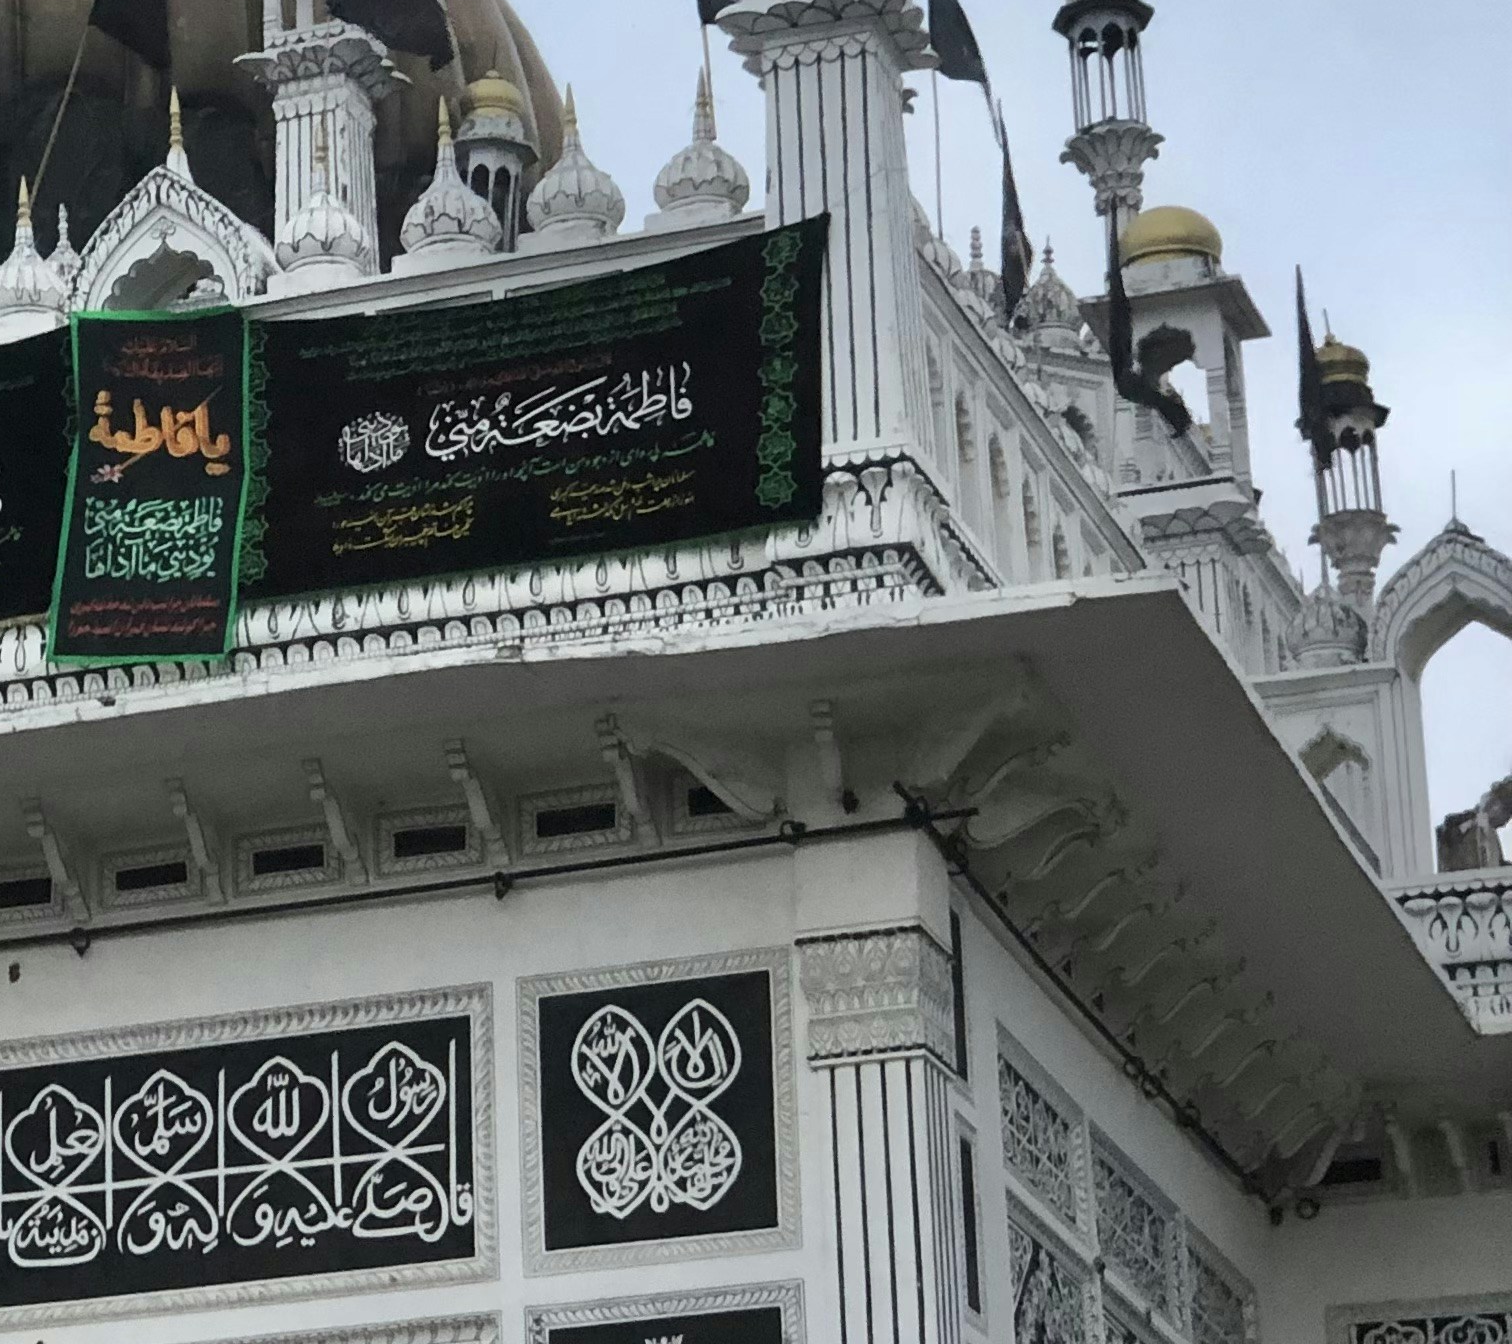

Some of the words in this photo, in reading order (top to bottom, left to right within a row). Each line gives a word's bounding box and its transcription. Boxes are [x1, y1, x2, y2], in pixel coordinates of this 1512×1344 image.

[89, 390, 199, 457] فاطمة
[425, 394, 492, 460] مني
[483, 376, 608, 448] بضعة
[596, 361, 693, 437] فاطمة
[195, 399, 231, 475] يا
